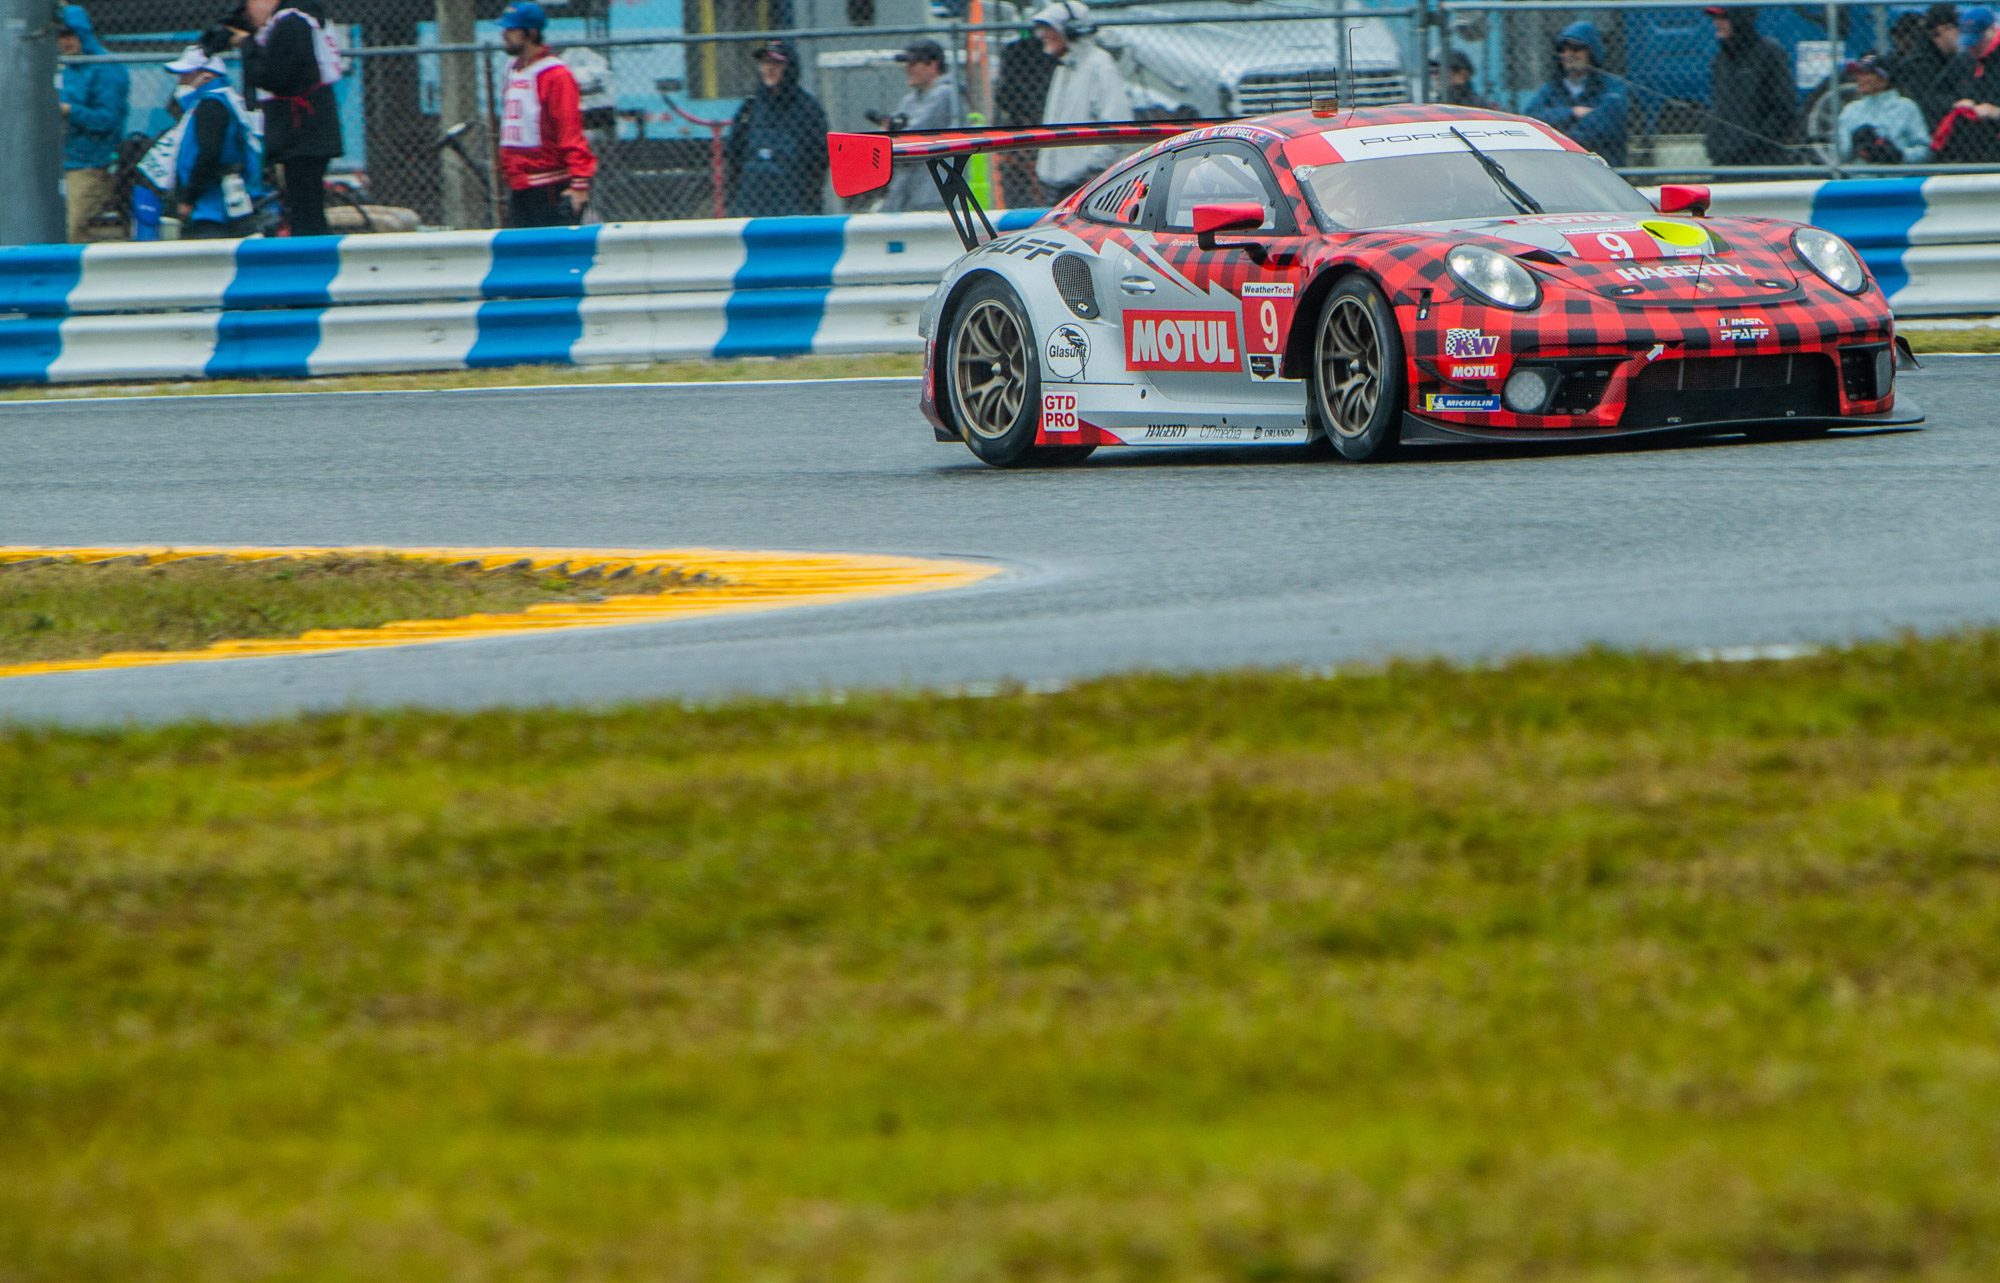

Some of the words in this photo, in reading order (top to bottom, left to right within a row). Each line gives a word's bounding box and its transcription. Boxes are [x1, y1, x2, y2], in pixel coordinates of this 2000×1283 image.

[1360, 130, 1530, 146] PORSCHE
[1597, 232, 1635, 260] 9
[1615, 264, 1747, 281] HAGERTY
[1244, 286, 1292, 294] WeatherTech
[1260, 300, 1279, 352] 9
[1132, 319, 1235, 364] MOTUL
[1720, 328, 1769, 341] PFAFF
[1454, 338, 1496, 355] KW
[1452, 366, 1496, 377] MOTUL
[1045, 395, 1076, 410] GTD
[1446, 399, 1494, 407] MICHELIN
[1046, 412, 1076, 428] PRO
[1145, 424, 1187, 438] HAGERTY
[1264, 428, 1295, 438] ORLANDO
